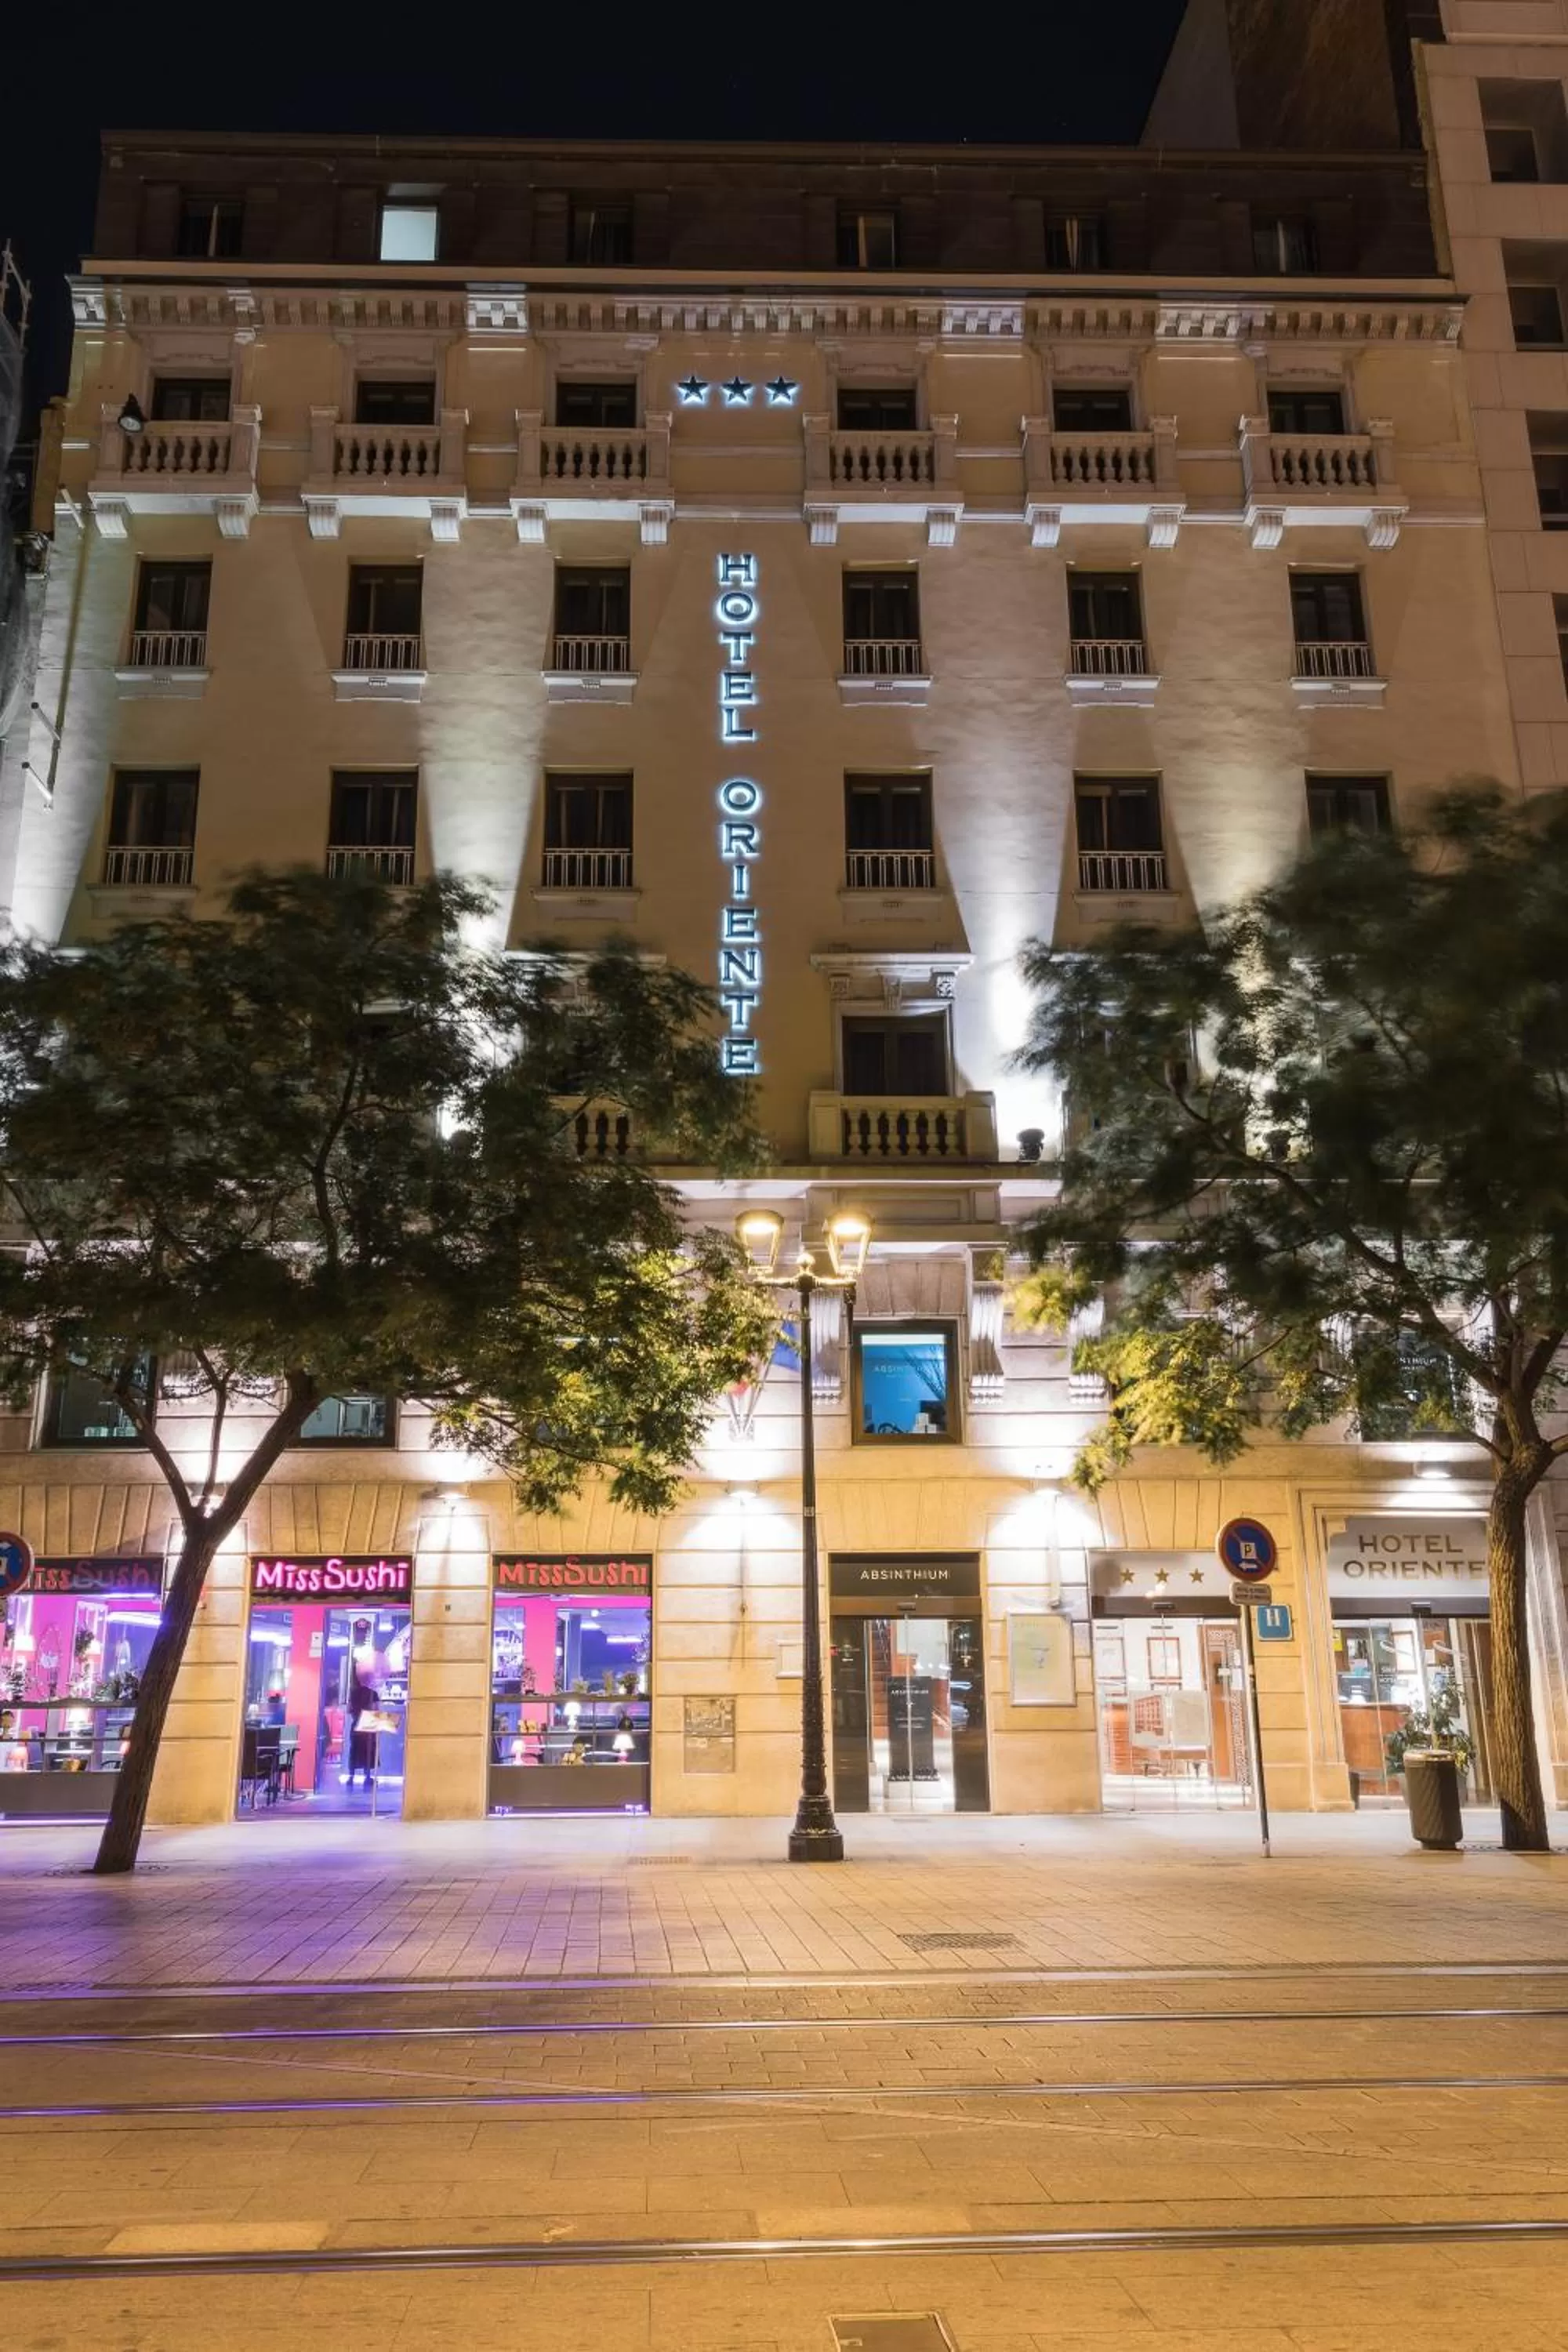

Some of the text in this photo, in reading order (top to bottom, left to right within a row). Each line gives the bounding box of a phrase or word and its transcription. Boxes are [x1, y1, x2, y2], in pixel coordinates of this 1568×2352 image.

[718, 553, 759, 1074] HOTEL ORIENTE
[1359, 1534, 1464, 1553] HOTEL
[24, 1560, 162, 1590] issSushi
[256, 1559, 408, 1592] MissSushi
[498, 1555, 649, 1586] MissSushi
[860, 1569, 949, 1581] ABSINTHIUM
[1343, 1559, 1486, 1581] ORIENTE
[1264, 1608, 1281, 1627] H
